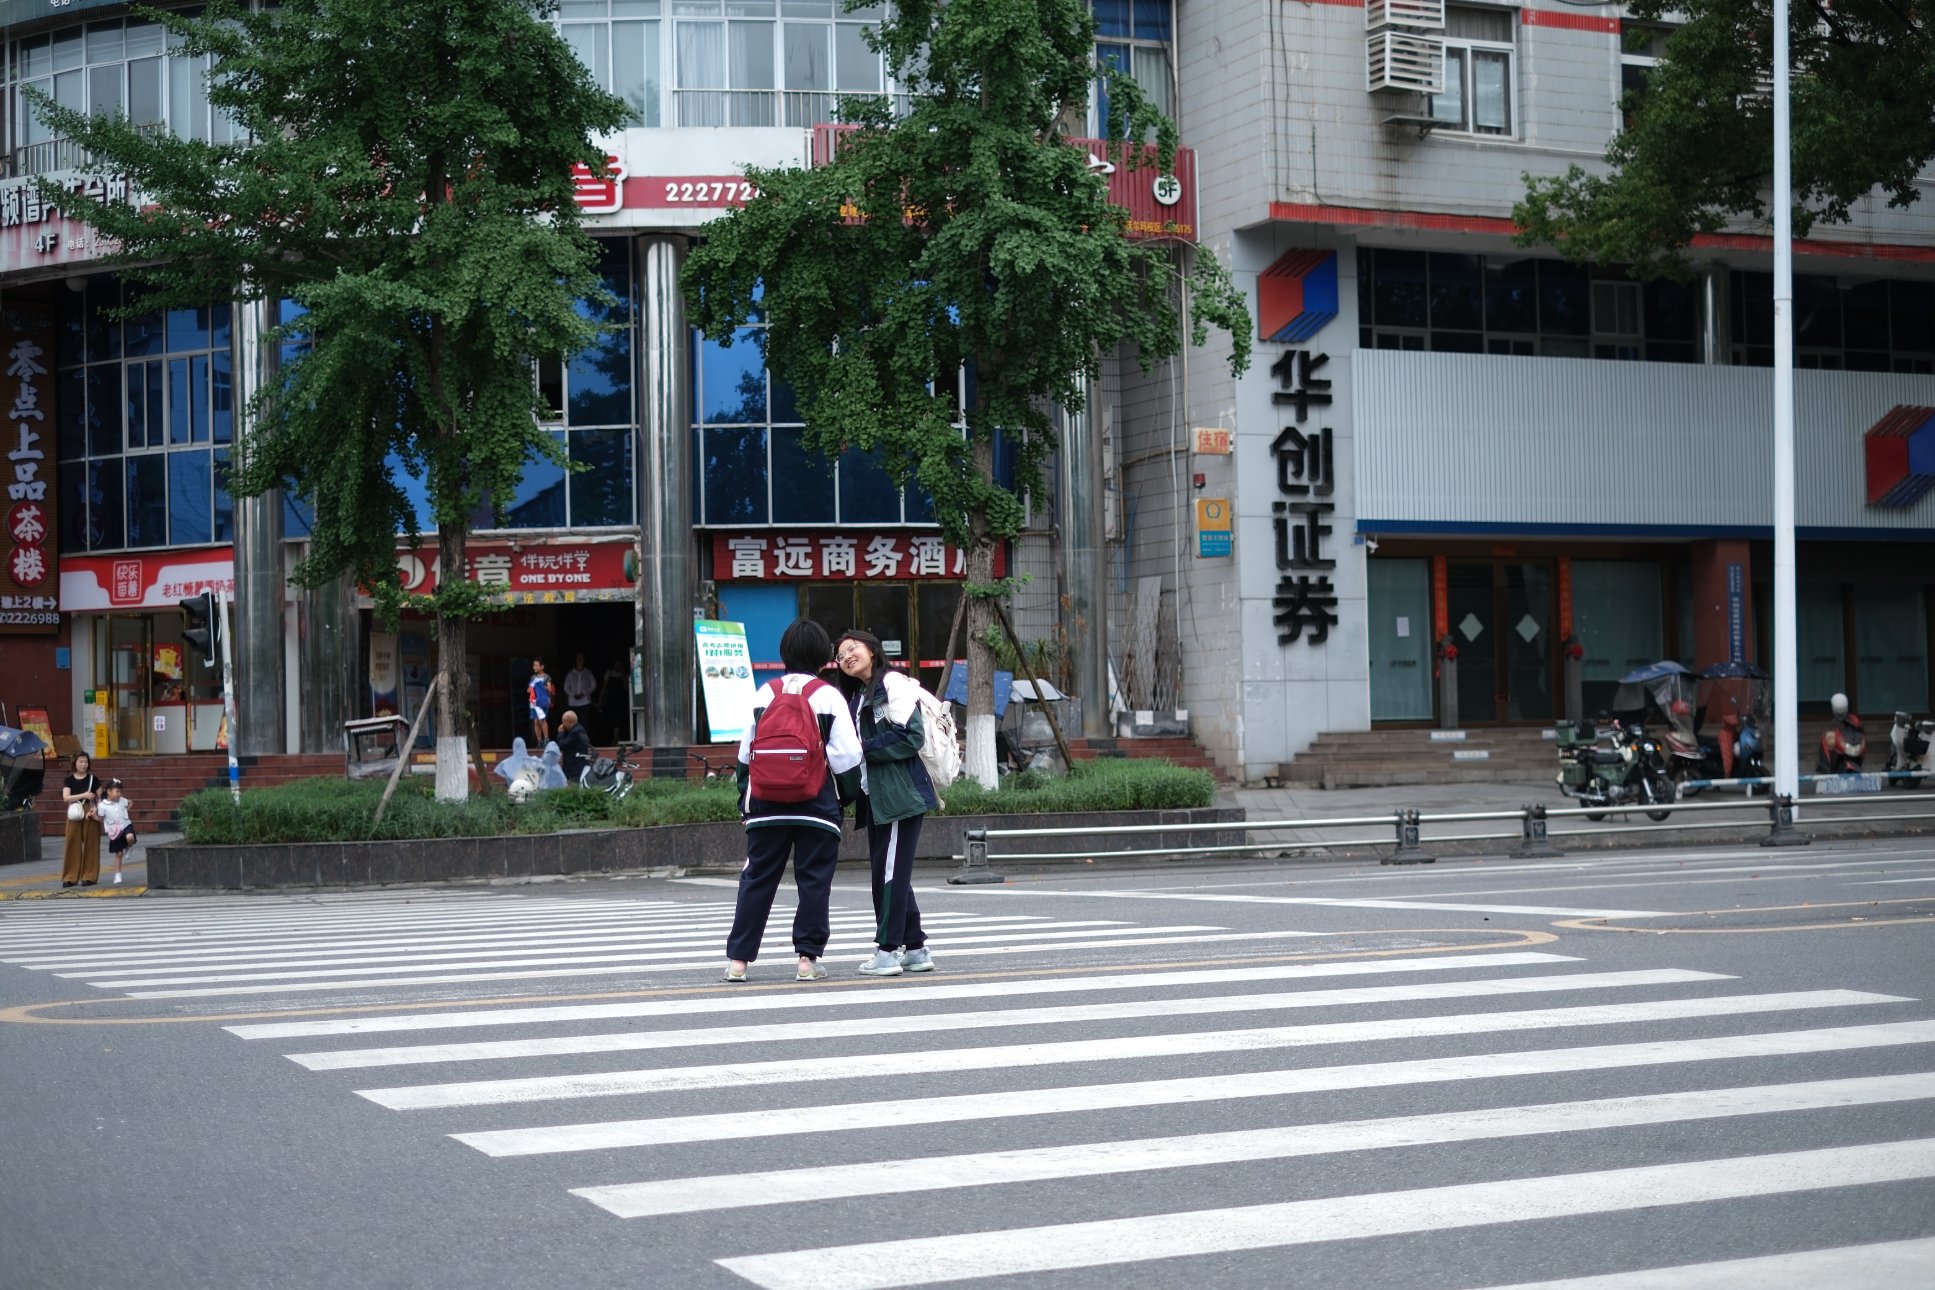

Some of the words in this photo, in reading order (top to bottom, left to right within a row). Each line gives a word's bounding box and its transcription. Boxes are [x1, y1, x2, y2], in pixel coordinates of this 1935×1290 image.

[1158, 180, 1178, 198] 5F
[33, 233, 58, 253] 4F
[1270, 349, 1338, 646] 华创证券
[520, 574, 545, 584] ONE
[547, 574, 564, 583] BY
[565, 573, 591, 583] ONE
[7, 612, 60, 624] 2226988
